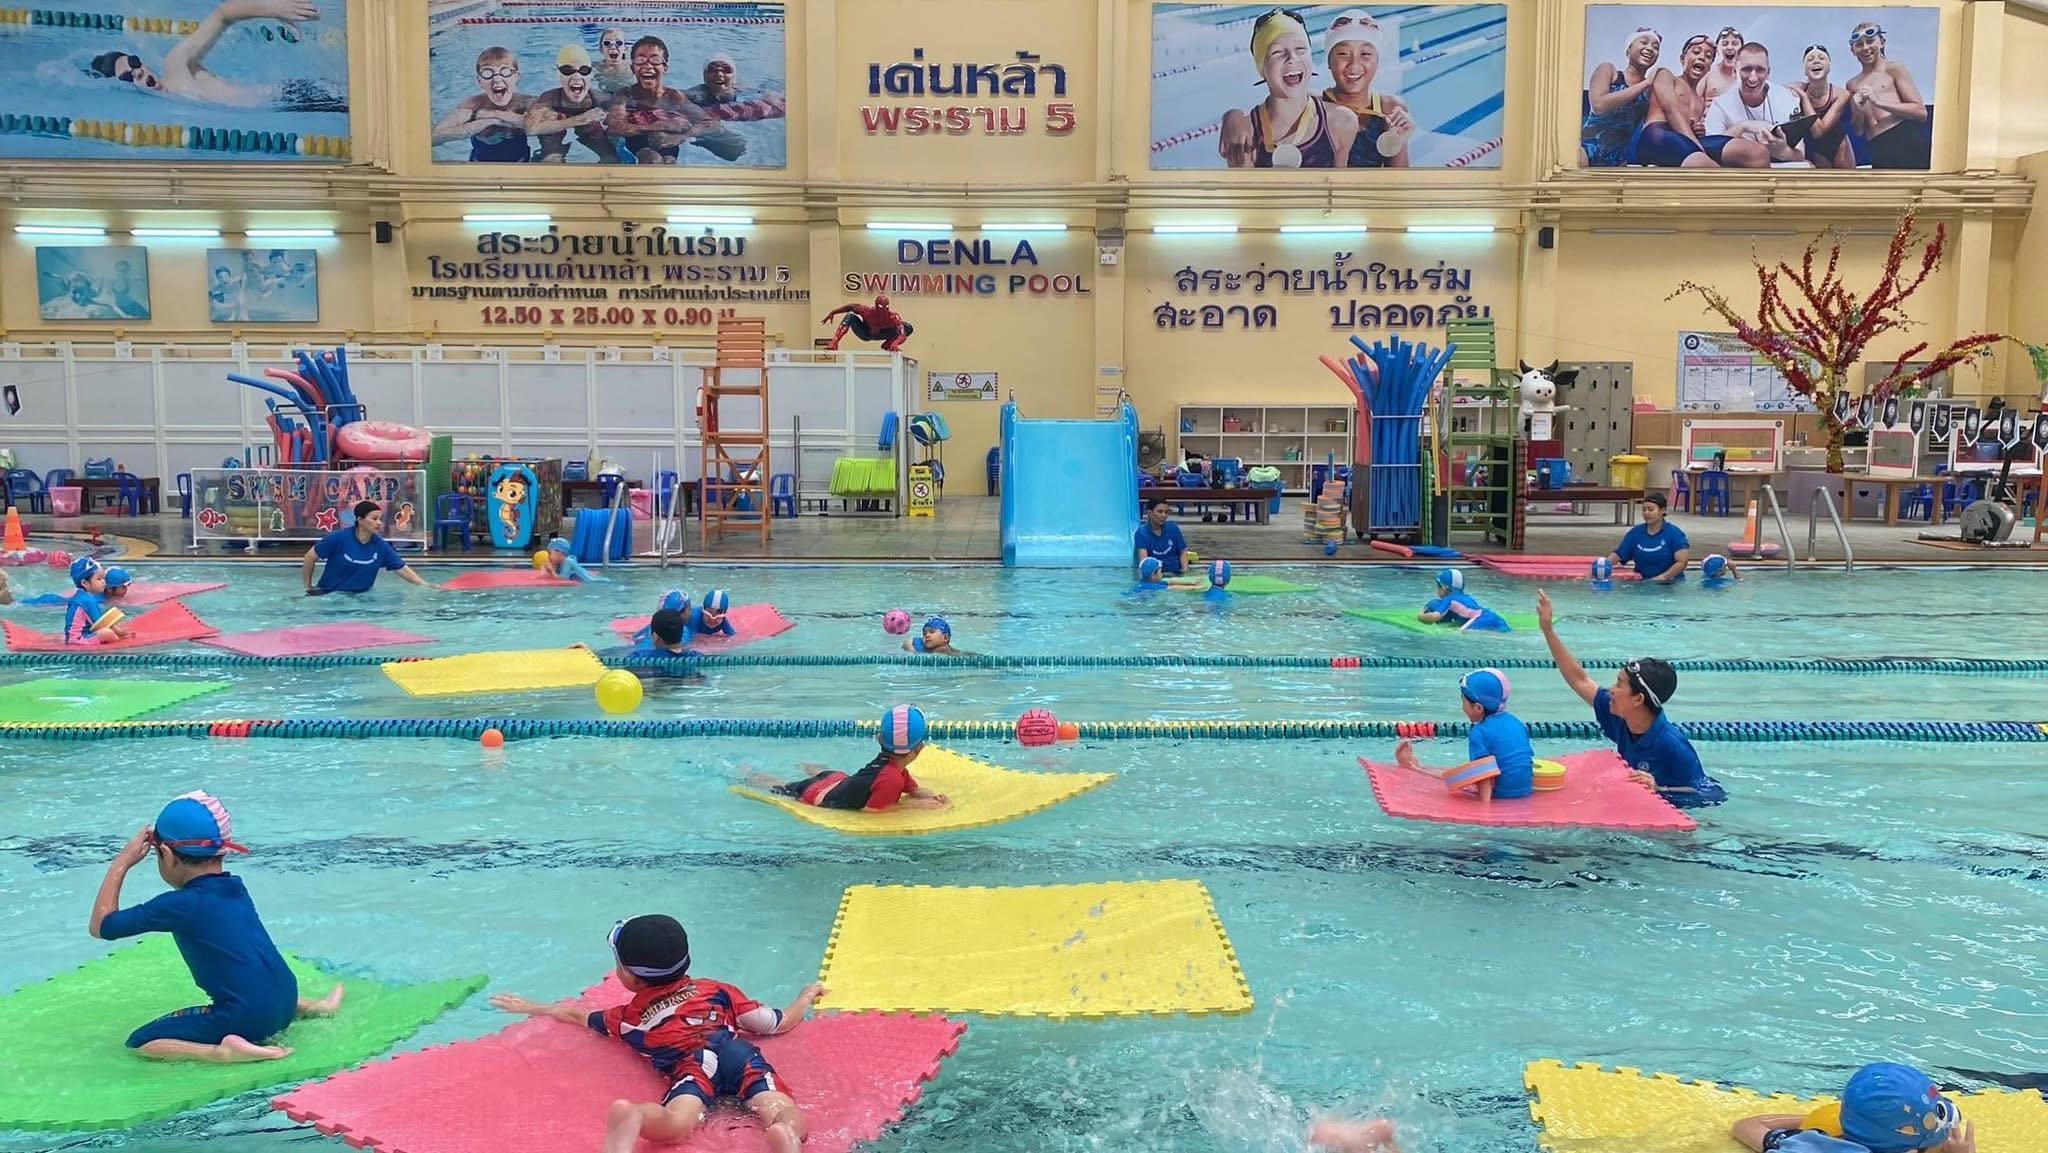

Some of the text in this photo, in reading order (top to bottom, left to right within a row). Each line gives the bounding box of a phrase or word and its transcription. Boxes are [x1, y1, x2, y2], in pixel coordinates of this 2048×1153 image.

[868, 48, 1068, 97] เด่นหล้า
[860, 102, 1077, 136] พระราม 5
[476, 221, 747, 258] สระว่ายน้ำในร่ม
[897, 238, 1039, 266] DENLA
[428, 255, 792, 283] โรงเรียนเด่นหล้า พระราม 5
[844, 272, 1091, 294] SWIMMING POOL
[1174, 251, 1472, 293] สระว่ายน้ำในร่ม
[480, 306, 543, 325] 12.50
[572, 307, 635, 326] 25.00
[664, 307, 713, 326] 0.90
[1153, 301, 1278, 328] สะอาด
[227, 474, 400, 501] SWIM CAMP
